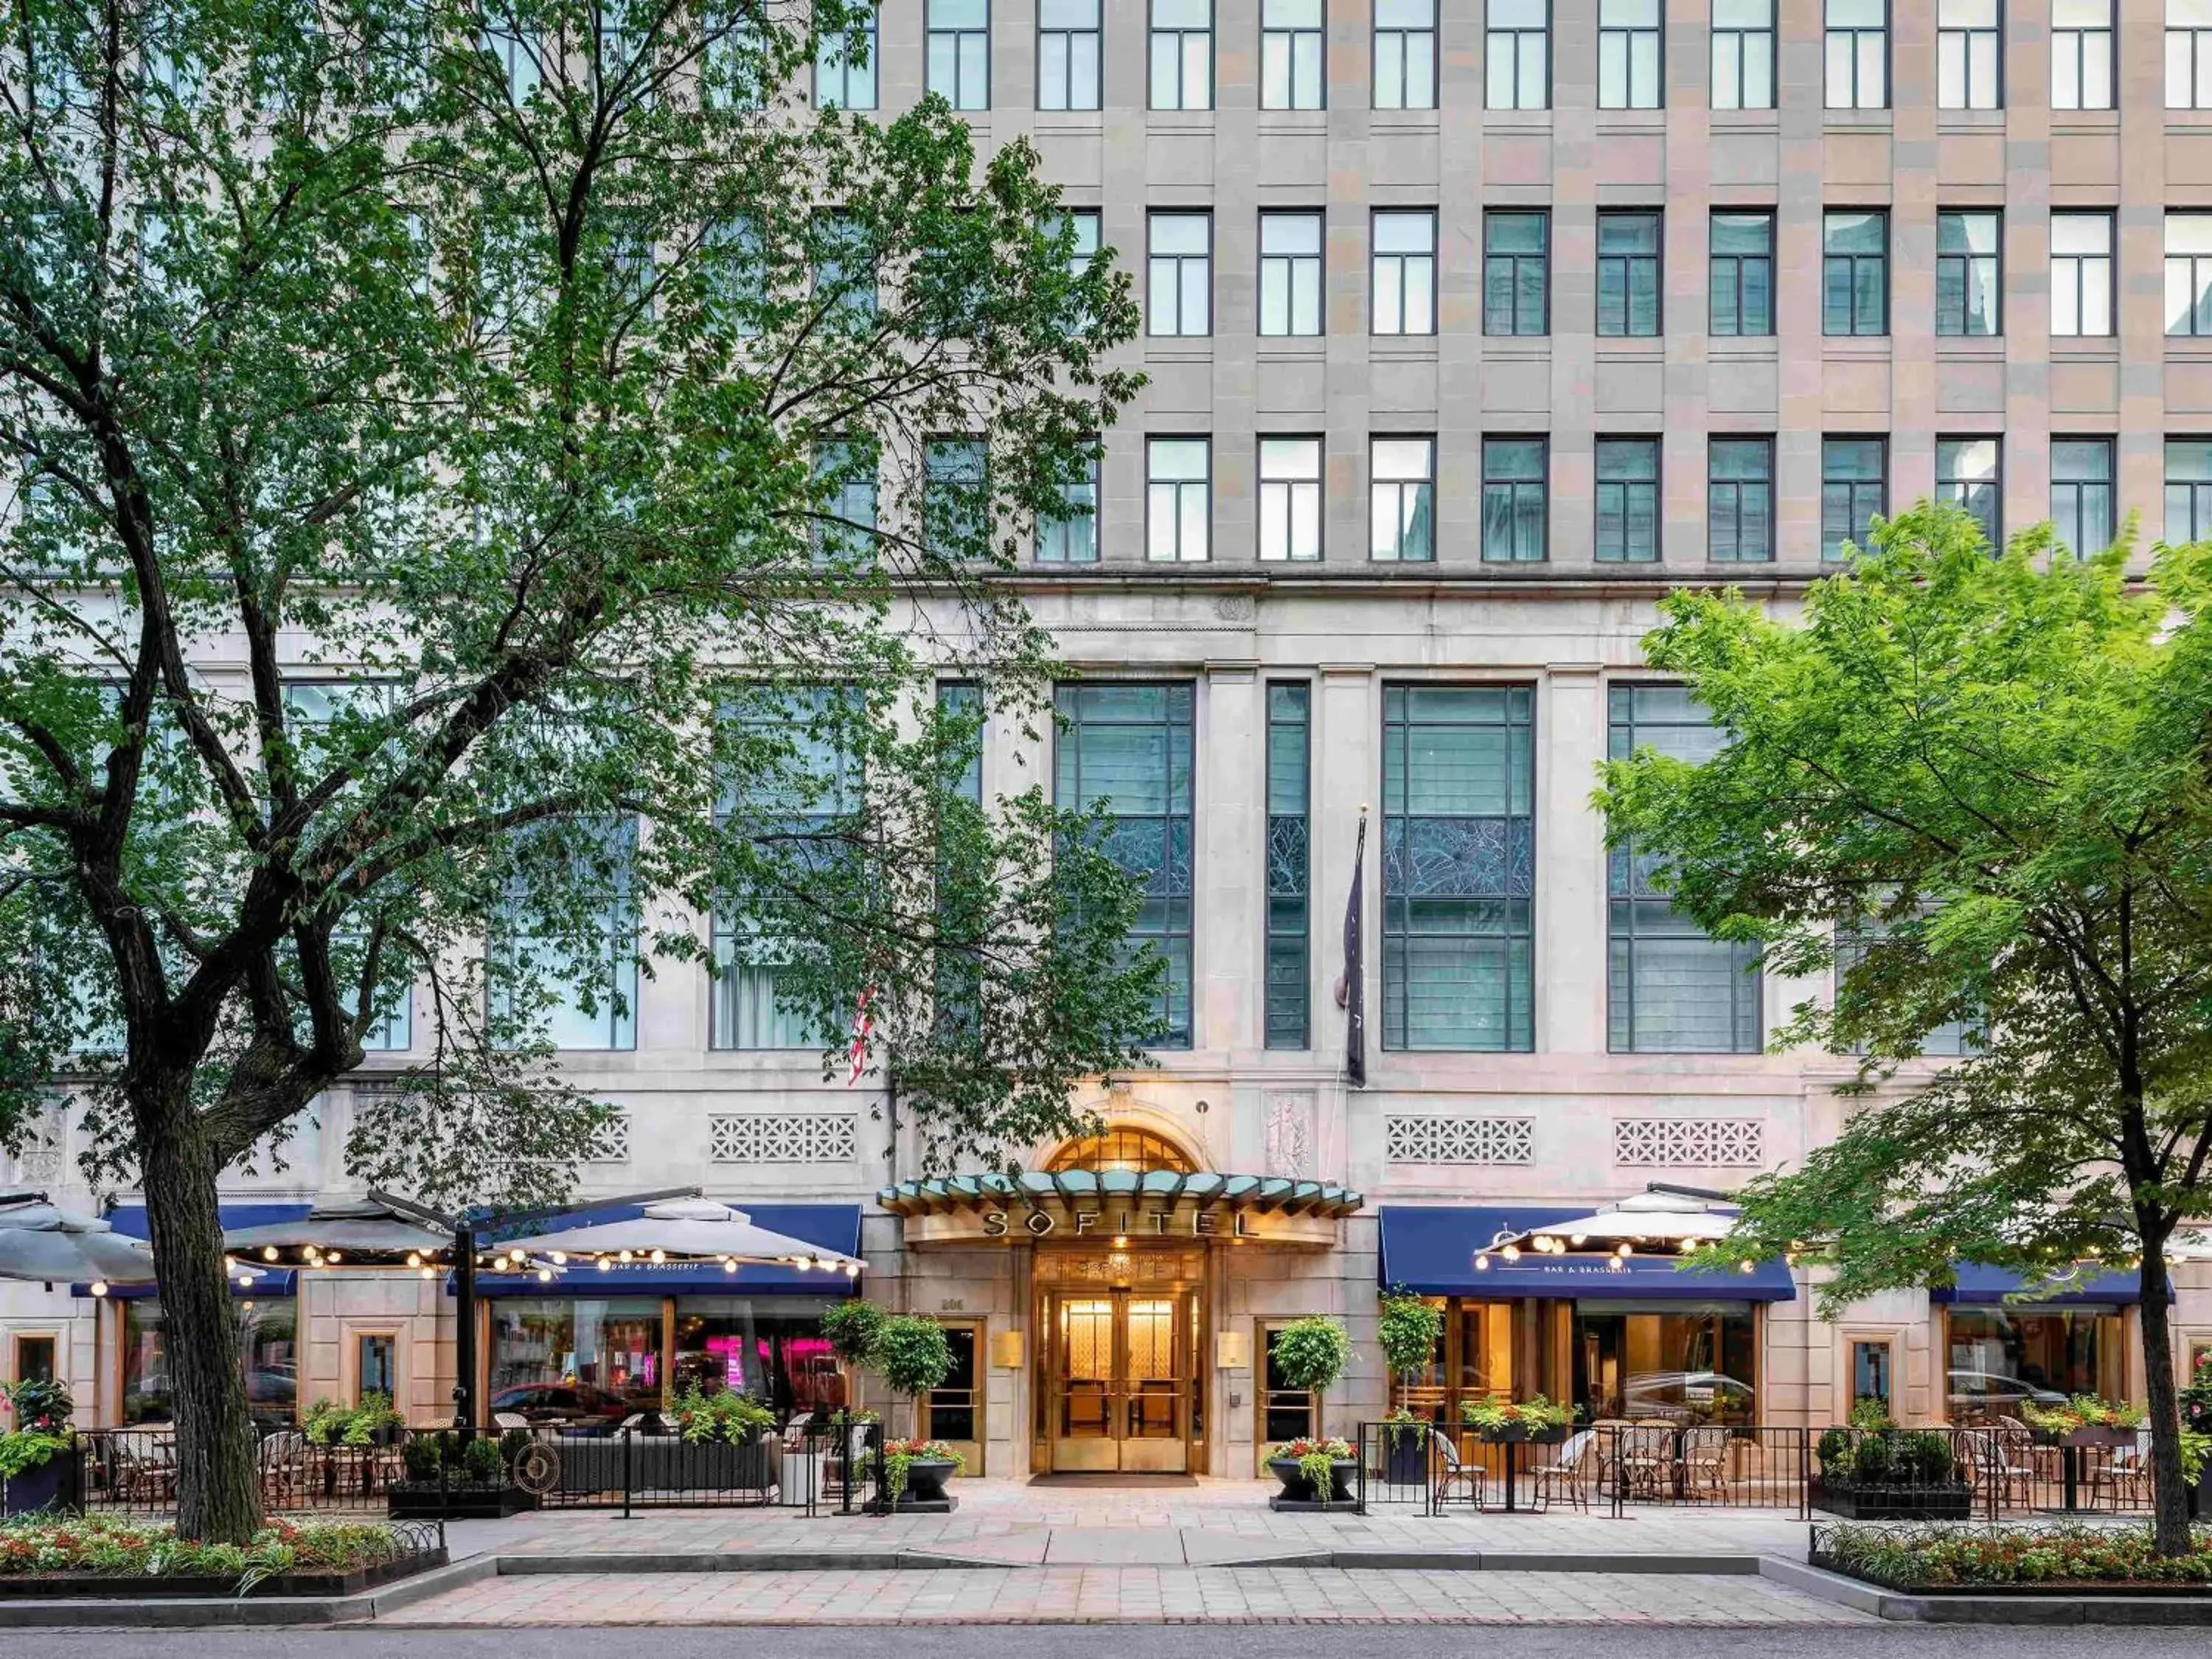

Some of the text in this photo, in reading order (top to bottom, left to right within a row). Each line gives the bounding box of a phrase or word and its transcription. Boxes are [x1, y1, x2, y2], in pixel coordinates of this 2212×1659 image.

[983, 1208, 1260, 1238] SOFITEL
[1544, 1266, 1632, 1274] BAR & BRASSERIE
